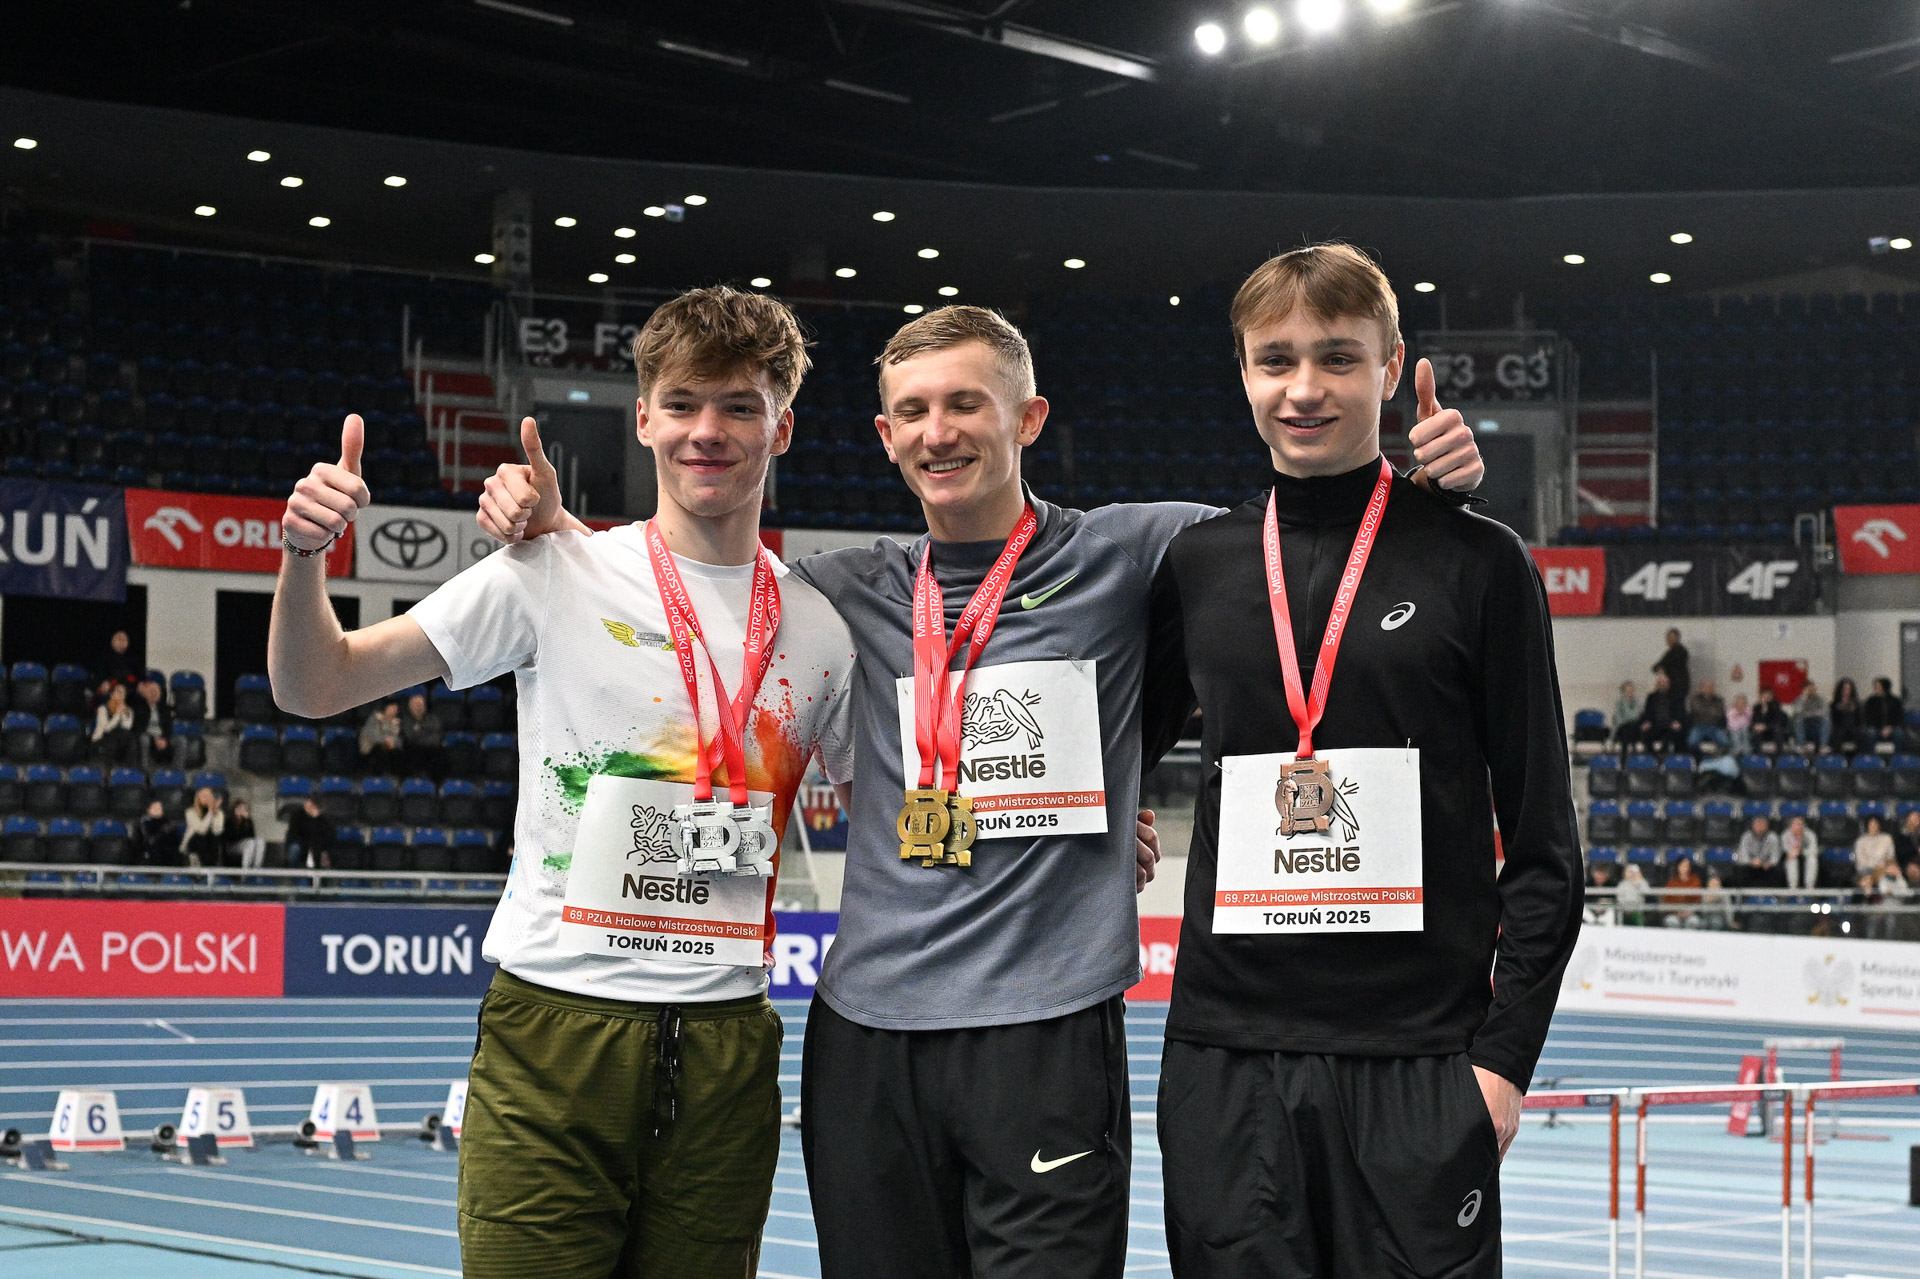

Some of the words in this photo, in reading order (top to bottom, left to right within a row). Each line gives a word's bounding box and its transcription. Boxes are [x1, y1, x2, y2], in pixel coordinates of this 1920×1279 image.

[519, 318, 568, 354] E3
[594, 323, 642, 360] F3
[1496, 354, 1549, 388] G3
[0, 498, 109, 570] UŃ
[1350, 480, 1388, 565] MISTRZOSTWA
[650, 533, 689, 614] MISTRZOSTWA
[1336, 567, 1358, 612] POLSKI
[1546, 567, 1590, 594] EN
[1620, 561, 1693, 600] 4F
[1726, 560, 1799, 600] 4F
[961, 552, 1015, 630] MISTRZOSTWA
[749, 572, 767, 653] MISTRZOSTWA
[668, 606, 688, 650] POLSKI
[681, 652, 695, 683] 2025
[1326, 613, 1345, 645] 2025
[958, 753, 1046, 784] Nestlé
[999, 795, 1065, 807] Mistrzostwa
[1067, 793, 1098, 806] Polski
[976, 813, 1011, 830] RUŃ
[1015, 814, 1059, 829] 2025
[1274, 846, 1361, 874] Nestlé
[621, 873, 710, 905] Nestlé
[1224, 893, 1241, 903] 69.
[1243, 893, 1267, 903] PZLA
[1270, 892, 1309, 902] Halowe
[1311, 891, 1379, 901] Mistrzostwa
[1382, 890, 1415, 900] Polski
[569, 910, 585, 922] 69.
[587, 913, 613, 925] PZLA
[615, 916, 656, 929] Halowe
[658, 919, 723, 935] Mistrzostwa
[726, 925, 758, 937] Polski
[1263, 908, 1321, 925] TORUŃ
[1326, 910, 1370, 924] 2025
[1, 930, 84, 972] WA
[102, 931, 257, 974] POLSKI
[321, 924, 472, 975] TORUŃ
[607, 934, 667, 952] TORUŃ
[672, 940, 715, 956] 2025
[60, 1104, 71, 1133] 6
[87, 1103, 107, 1134] 6
[188, 1101, 200, 1130] 5
[217, 1101, 236, 1131] 5
[317, 1098, 330, 1125] 4
[345, 1096, 364, 1125] 4
